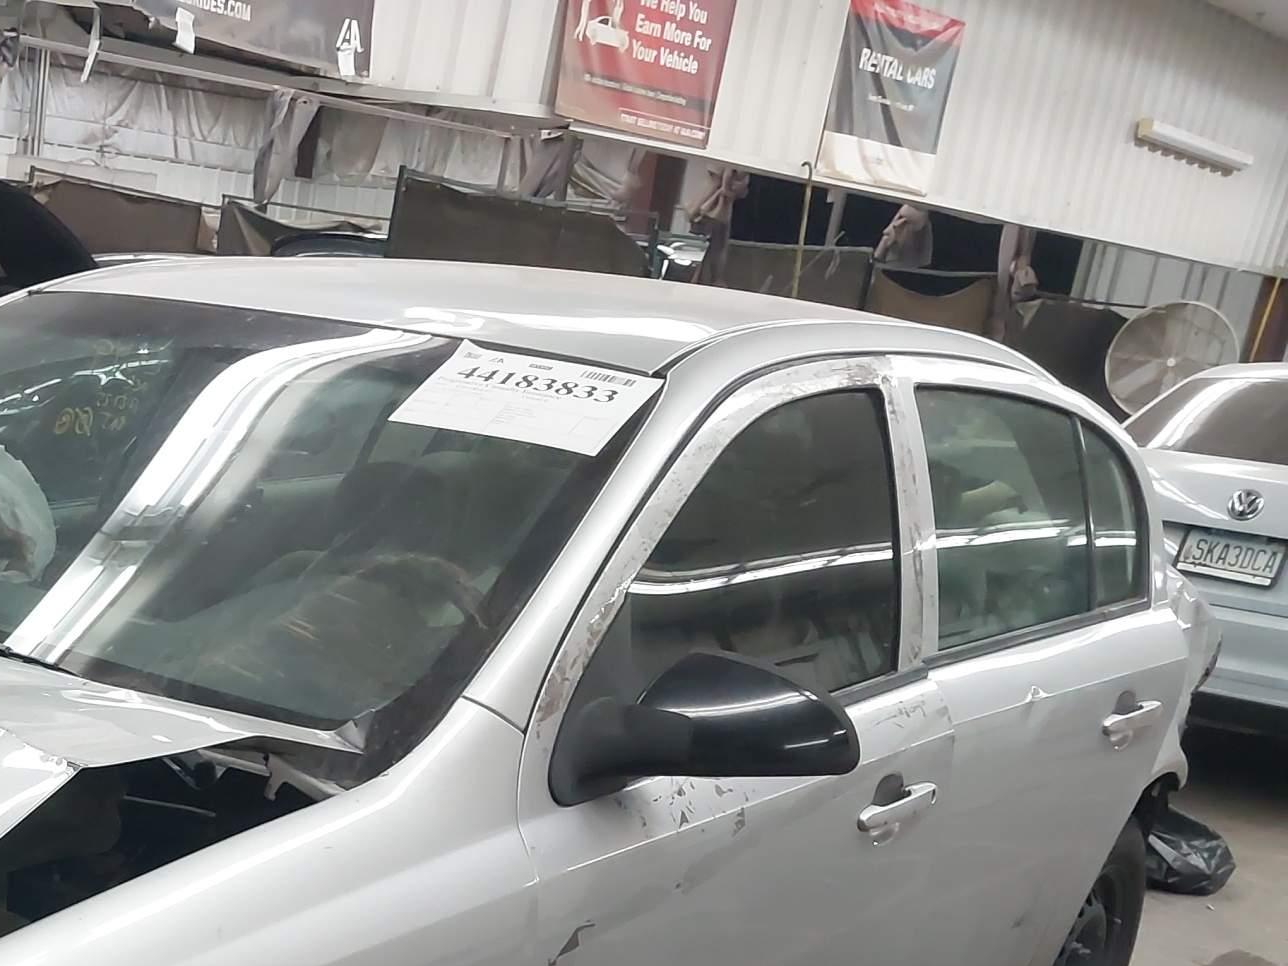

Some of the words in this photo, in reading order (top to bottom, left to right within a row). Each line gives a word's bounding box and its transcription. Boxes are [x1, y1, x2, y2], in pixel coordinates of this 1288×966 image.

[177, 0, 251, 22] IDES.COM
[660, 0, 685, 21] Help
[688, 1, 708, 25] You
[635, 13, 662, 38] Earn
[663, 21, 691, 46] More
[693, 31, 712, 51] For
[631, 39, 657, 63] Your
[660, 47, 699, 74] Vehicle
[906, 66, 936, 89] CARS
[457, 366, 619, 403] 44183833
